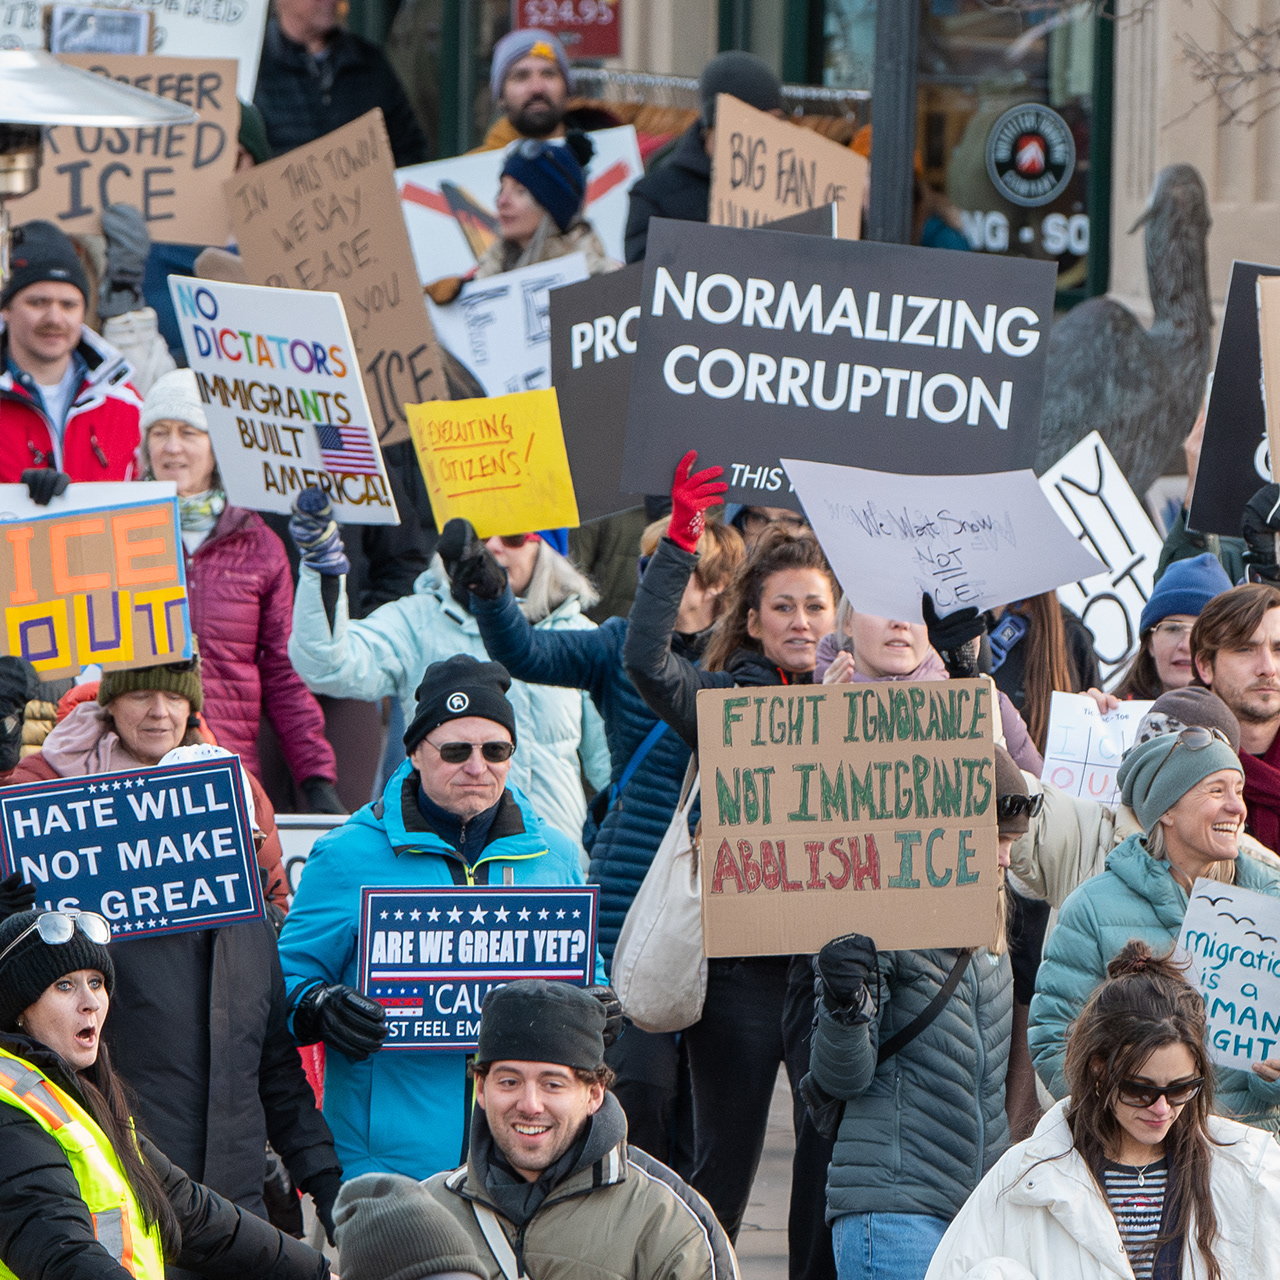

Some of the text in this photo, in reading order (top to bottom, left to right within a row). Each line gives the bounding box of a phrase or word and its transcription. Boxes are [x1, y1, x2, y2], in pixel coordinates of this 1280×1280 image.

[89, 64, 221, 110] EFER
[40, 119, 227, 168] RUSHED
[730, 131, 767, 192] BIG
[776, 147, 817, 208] FAN
[54, 159, 175, 221] ICE
[176, 282, 220, 321] NO
[650, 265, 1041, 358] NORMALIZING
[192, 323, 348, 379] DICTATORS
[195, 371, 352, 425] IMMIGRANTS
[366, 343, 430, 447] ICE
[662, 344, 1014, 431] CORRUPTION
[235, 416, 304, 459] BUILT
[427, 411, 515, 447] EXECUTING
[262, 460, 392, 508] AMERICA!
[730, 463, 783, 493] THIS
[936, 508, 994, 536] Snow
[5, 508, 178, 606] ICE
[4, 585, 188, 673] OUT
[722, 686, 990, 748] FIGHT IGNORANCE
[12, 782, 230, 840] HATE WILL
[715, 753, 993, 826] NOT IMMIGRANTS
[19, 826, 238, 885] NOT MAKE
[710, 827, 981, 894] ABOLISH ICE
[99, 872, 241, 921] GREAT
[371, 929, 587, 964] ARE WE GREAT YET?
[1200, 967, 1259, 1001] is a
[413, 1021, 451, 1037] FEEL
